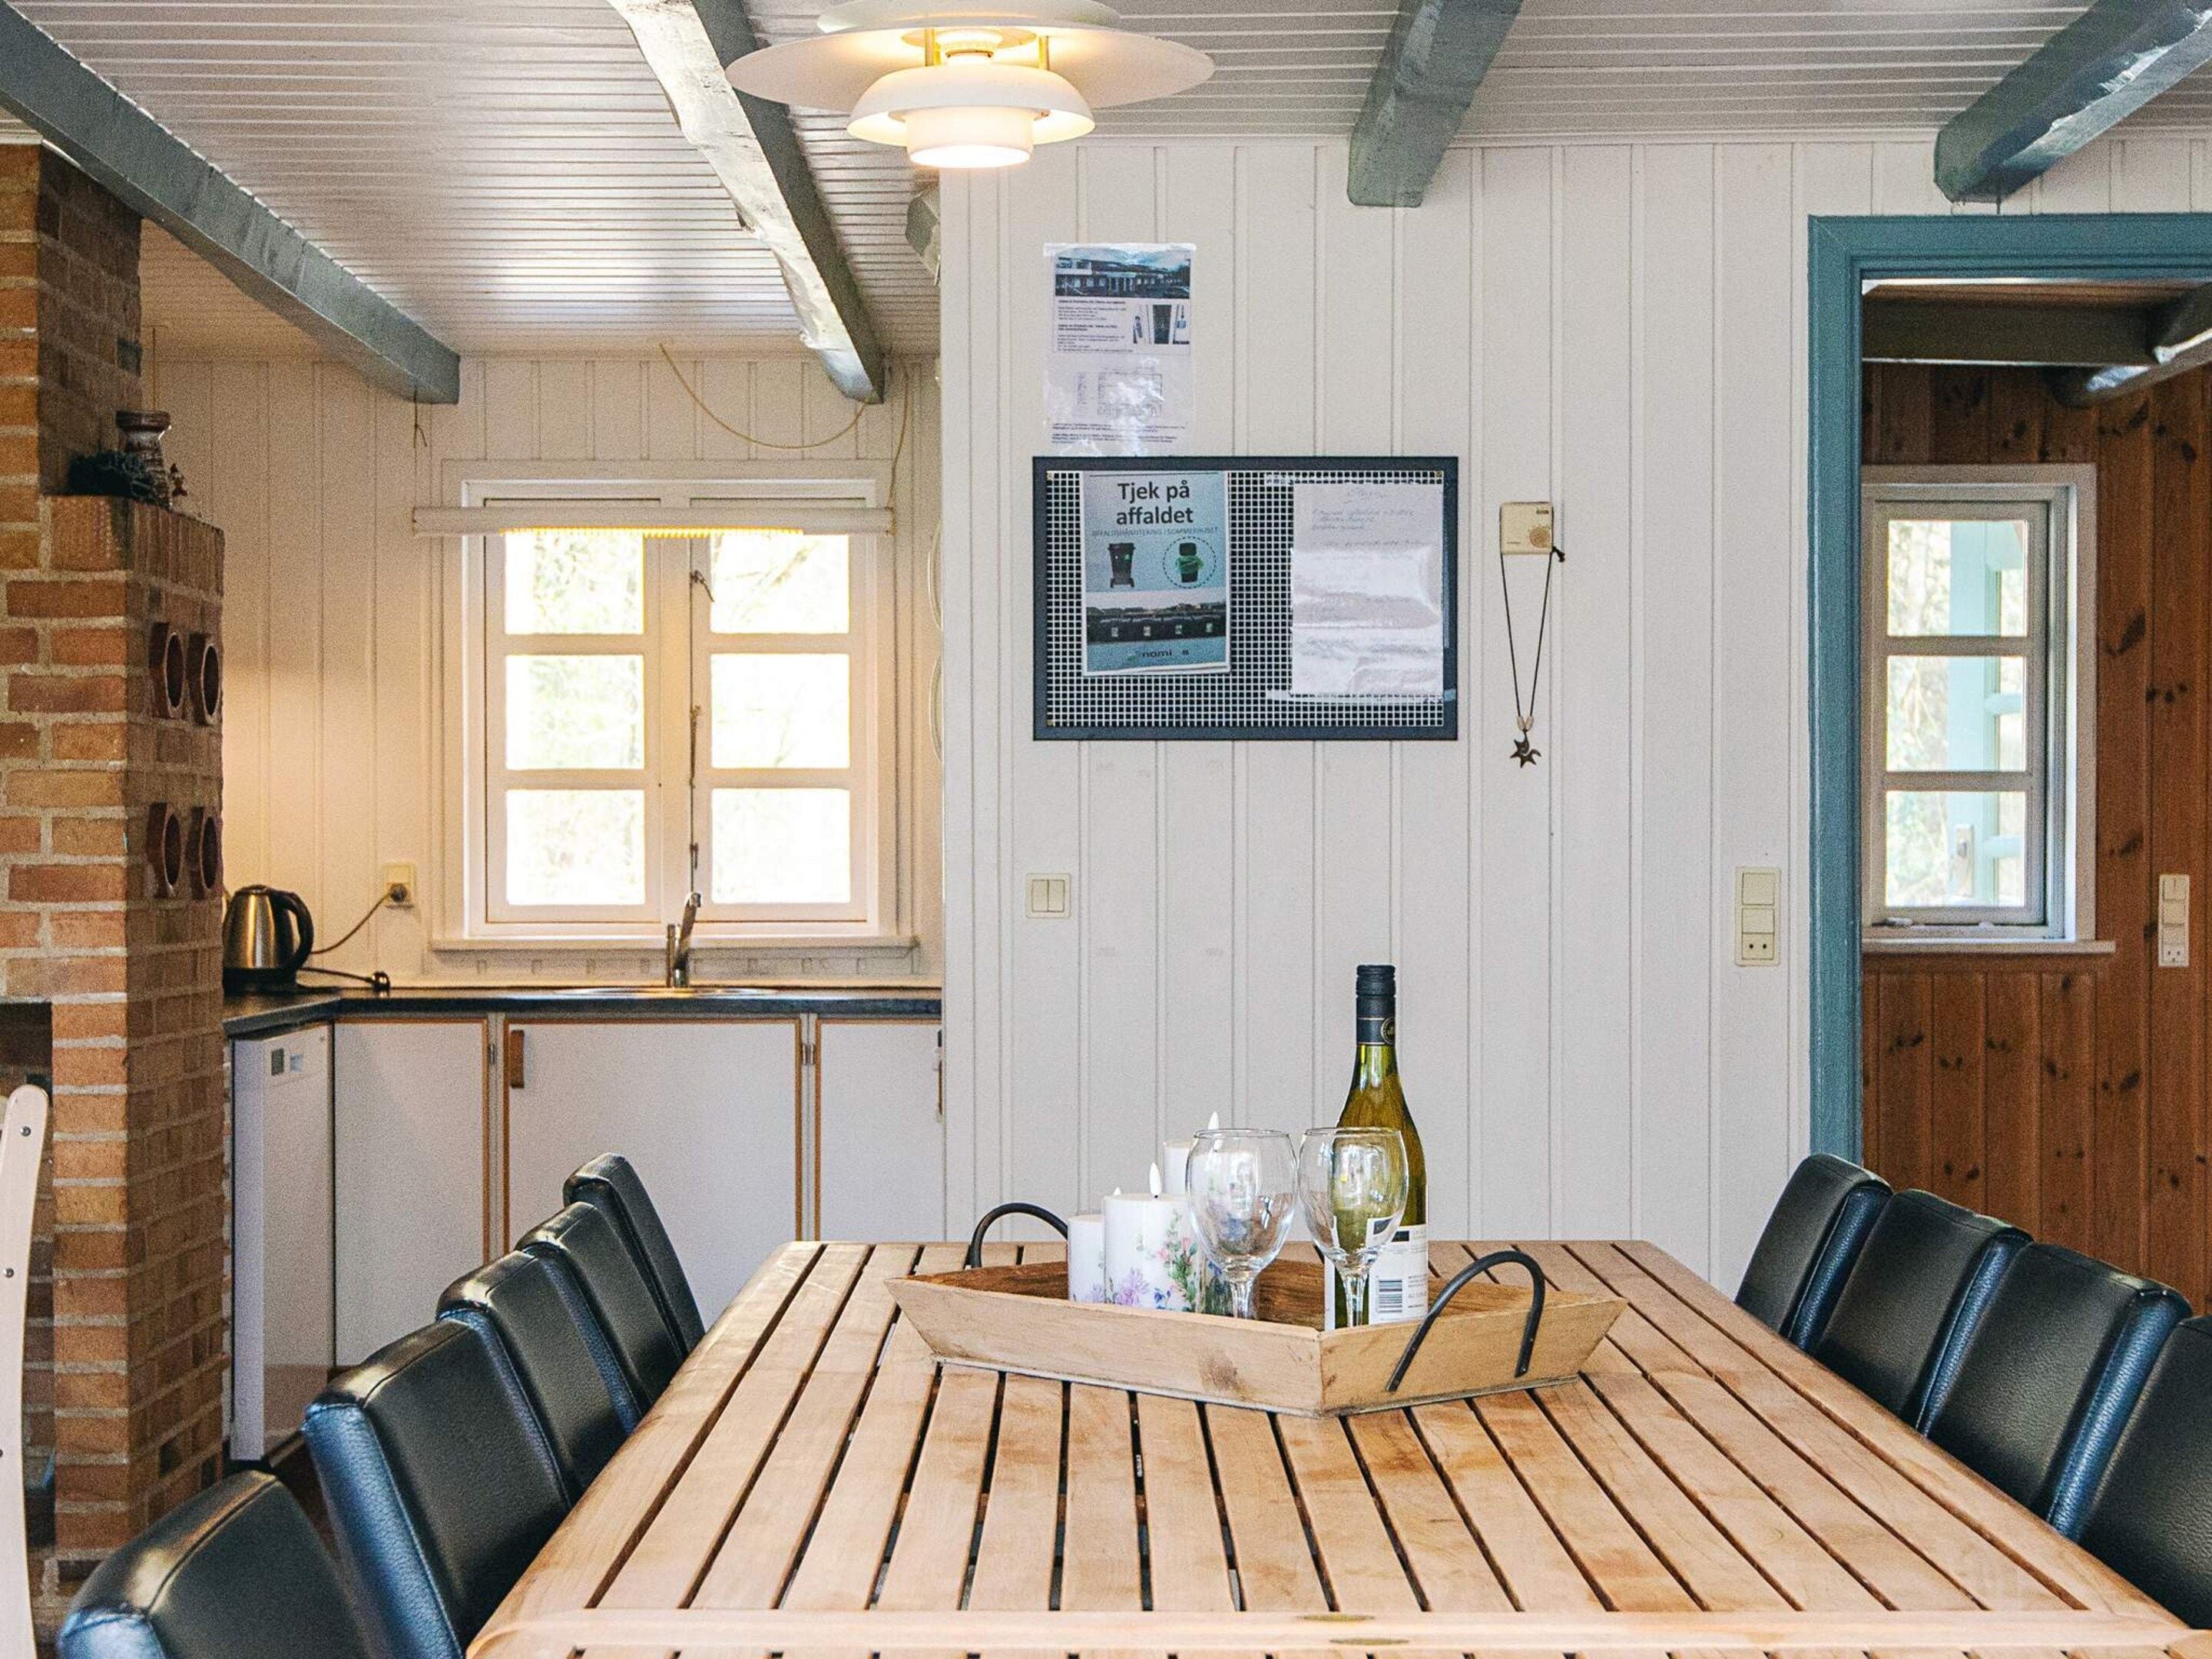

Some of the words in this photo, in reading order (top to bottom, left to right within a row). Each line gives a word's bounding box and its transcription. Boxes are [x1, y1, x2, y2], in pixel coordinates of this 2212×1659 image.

[1117, 482, 1159, 503] Tjek
[1167, 480, 1190, 502] på
[1117, 506, 1193, 525] affaldet
